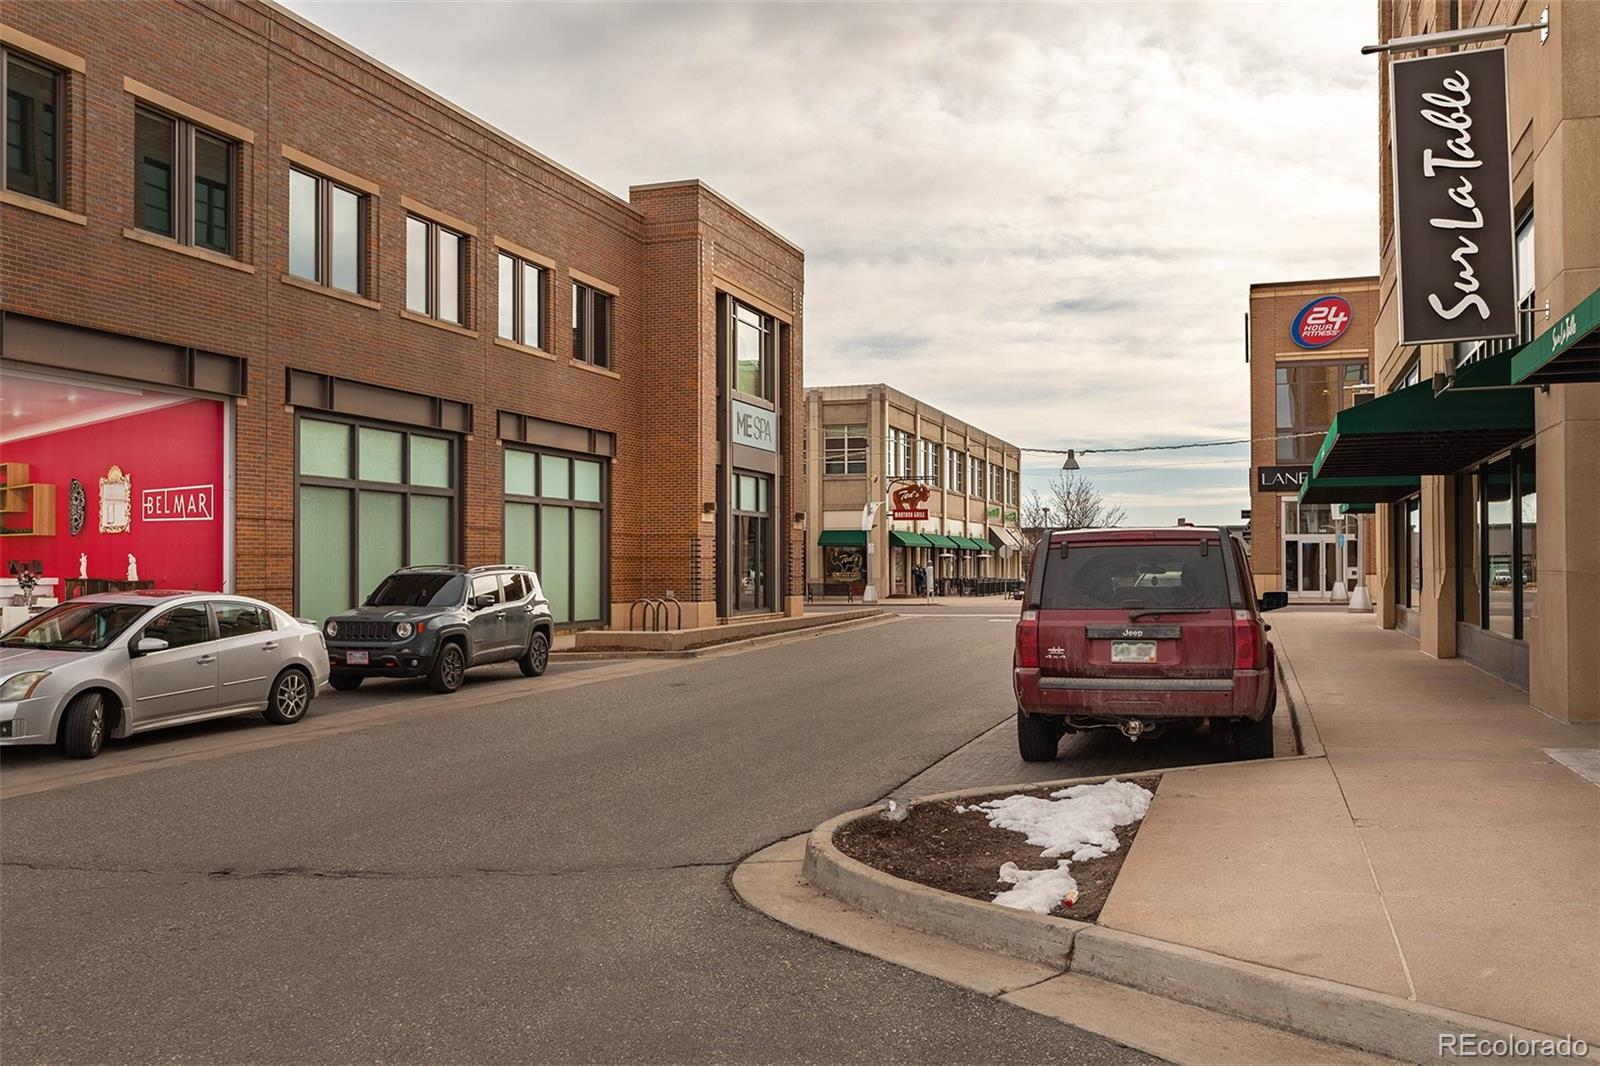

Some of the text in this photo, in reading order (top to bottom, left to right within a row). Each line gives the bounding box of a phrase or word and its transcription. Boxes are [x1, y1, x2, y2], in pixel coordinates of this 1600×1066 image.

[1420, 70, 1491, 320] Sur La Table
[1306, 306, 1348, 330] 24
[753, 416, 772, 443] SPA
[145, 492, 210, 518] BELMAR
[1122, 629, 1143, 638] Jeep
